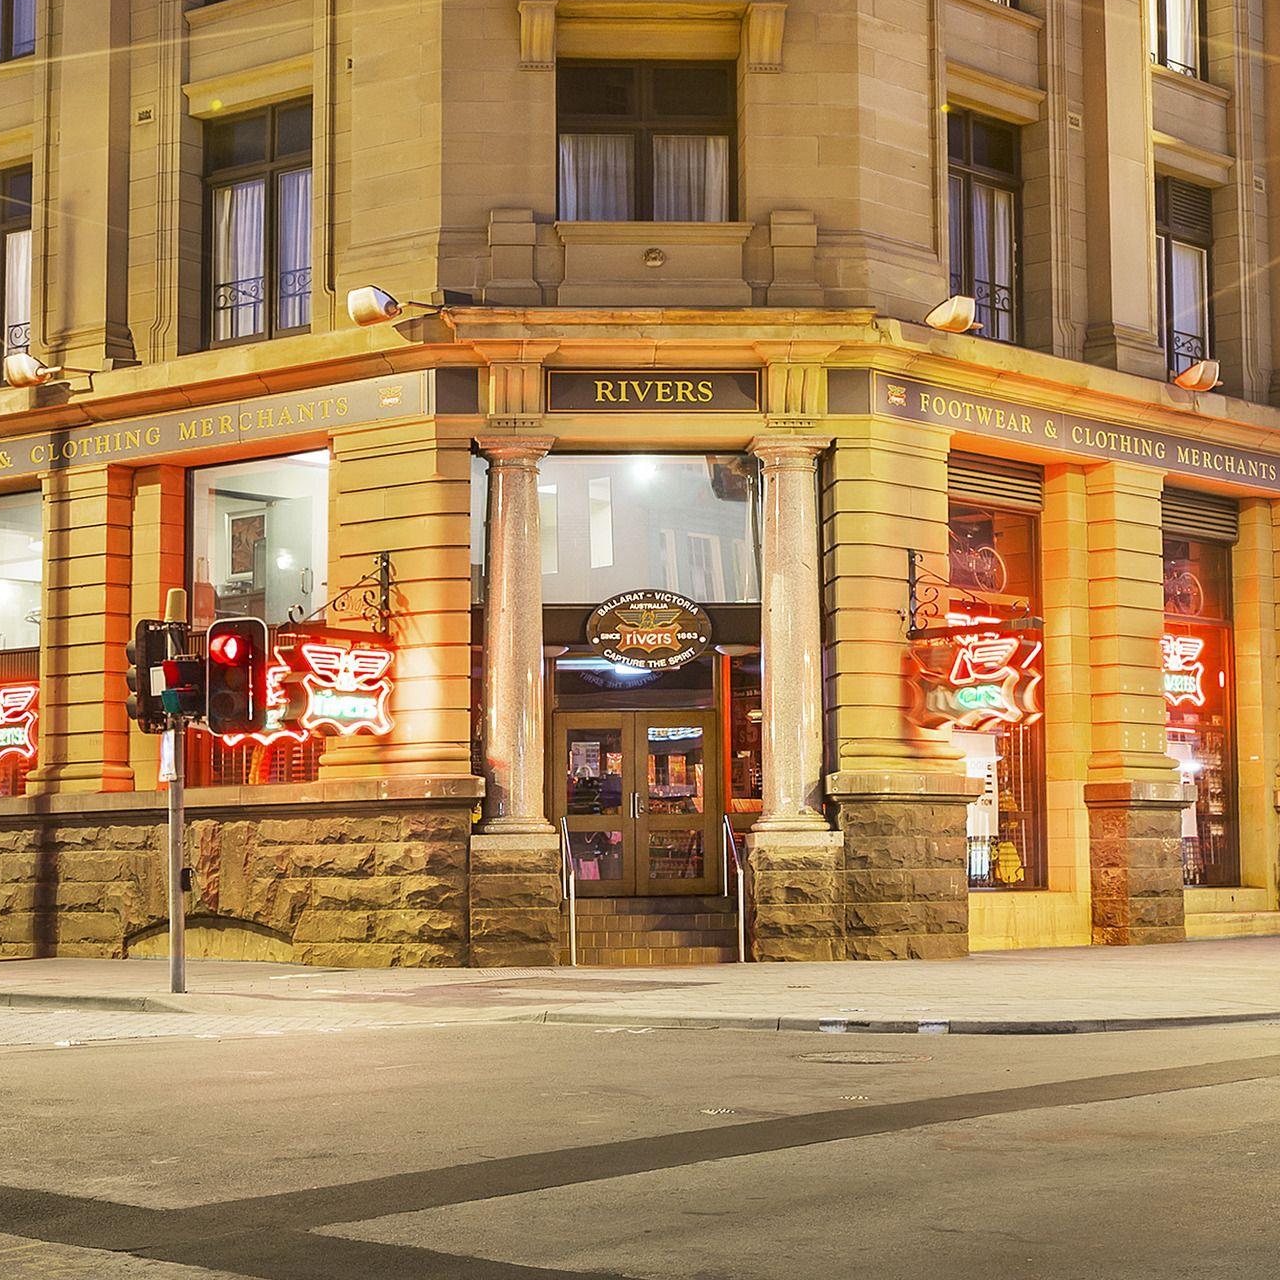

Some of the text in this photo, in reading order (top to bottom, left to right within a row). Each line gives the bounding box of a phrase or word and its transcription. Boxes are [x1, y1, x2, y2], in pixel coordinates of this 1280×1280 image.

[594, 380, 714, 403] RIVERS
[30, 426, 161, 465] CLOTHING
[179, 397, 349, 442] MERCHANTS
[920, 393, 1277, 481] FOOTWEAR & CLOTHING MERCHANTS
[597, 592, 645, 617] BALLARAT
[654, 592, 699, 616] VICTORIA
[626, 631, 672, 645] rivers
[603, 647, 696, 668] CAPTURE THE SPIRIT
